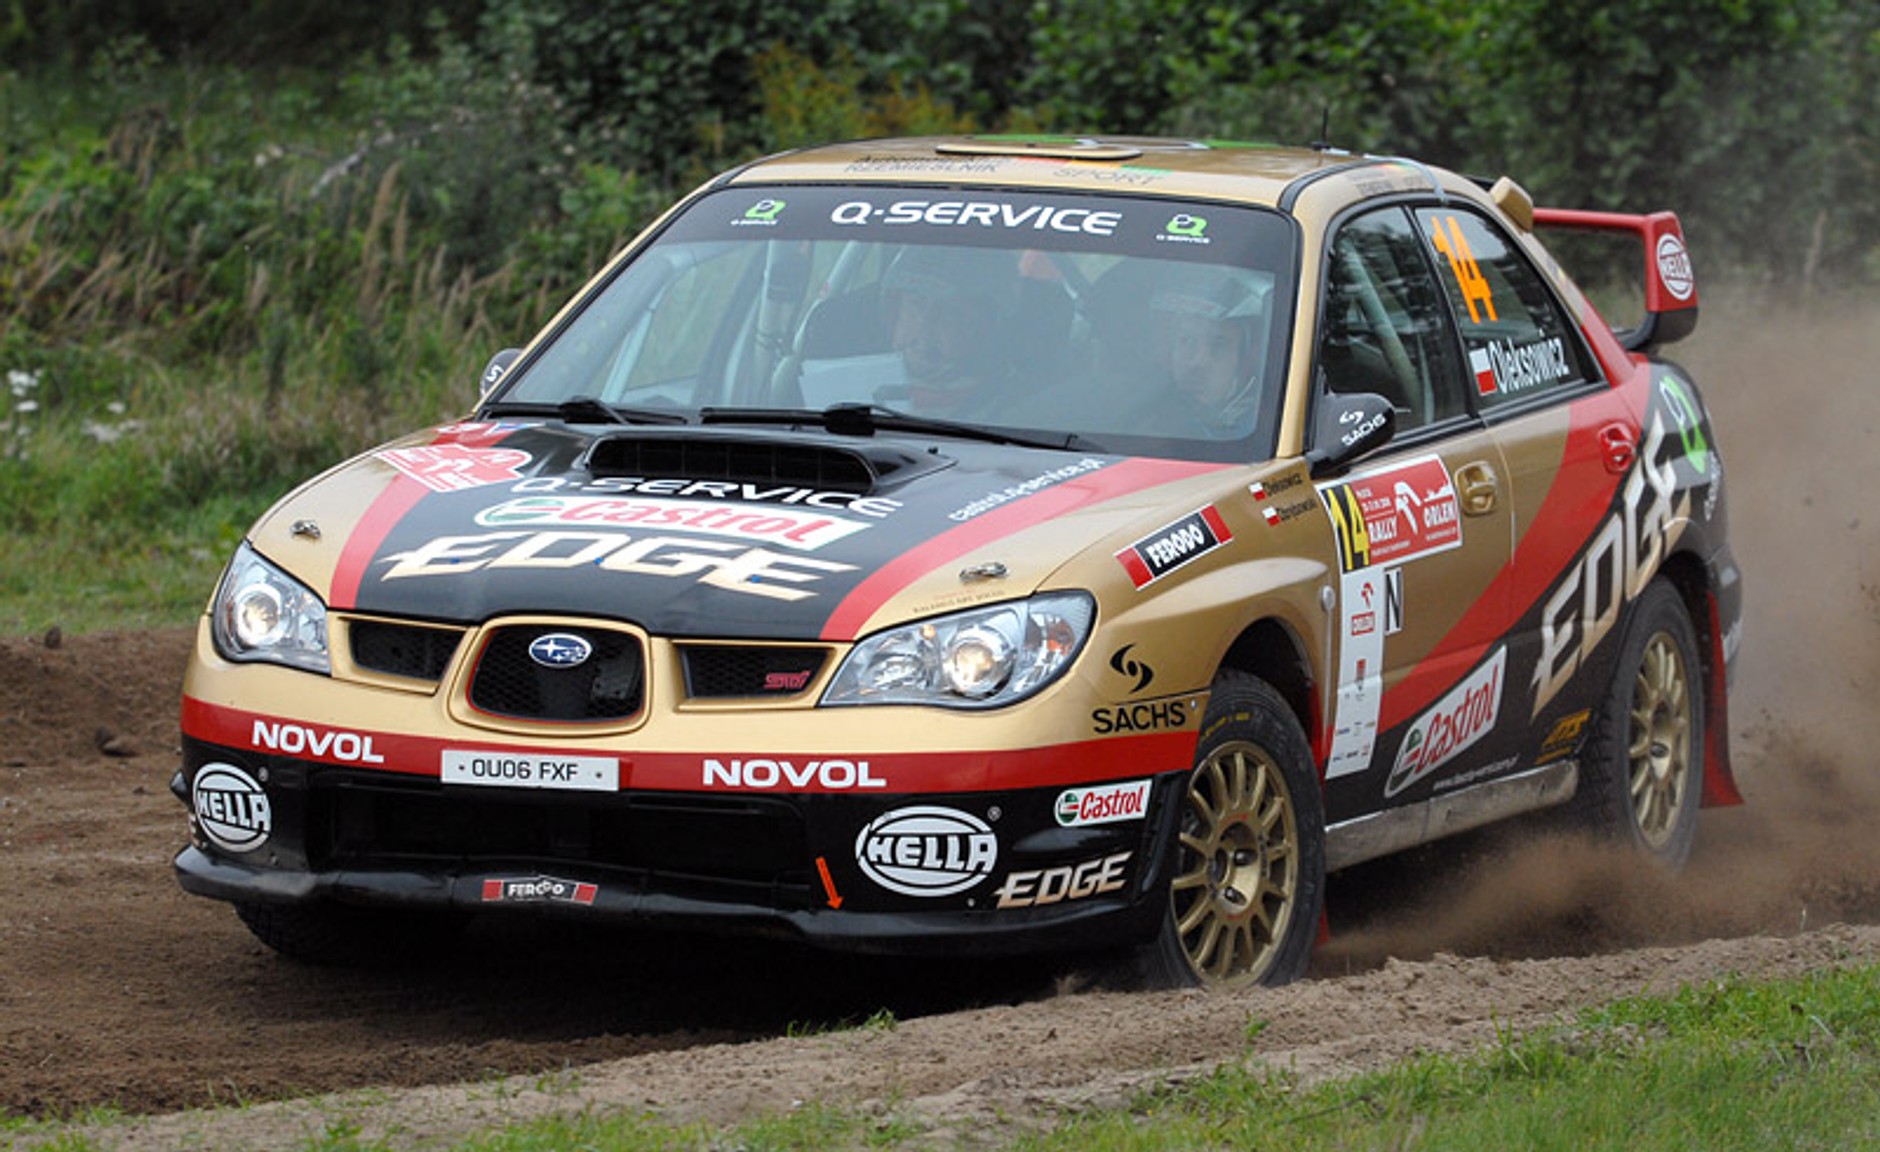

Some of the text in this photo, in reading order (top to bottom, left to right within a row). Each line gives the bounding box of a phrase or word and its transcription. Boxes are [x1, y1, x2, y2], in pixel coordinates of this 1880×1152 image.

[1431, 215, 1499, 324] 14
[557, 499, 836, 543] Castrol
[1326, 483, 1371, 572] 14
[1367, 515, 1398, 544] RALLY
[1423, 501, 1457, 529] ORLEN
[375, 530, 862, 601] EDGE
[1145, 522, 1206, 568] FERODO
[1530, 408, 1691, 720] EDGE
[1385, 571, 1401, 631] N
[1092, 701, 1186, 734] SACHS
[1415, 664, 1499, 774] Castrol
[251, 720, 385, 764] NOVOL
[470, 758, 579, 783] OU06 FXF
[702, 758, 887, 789] NOVOL
[199, 790, 271, 833] HELLA
[1078, 784, 1145, 822] Castrol
[864, 831, 998, 874] HELLA
[993, 851, 1133, 909] EDGE
